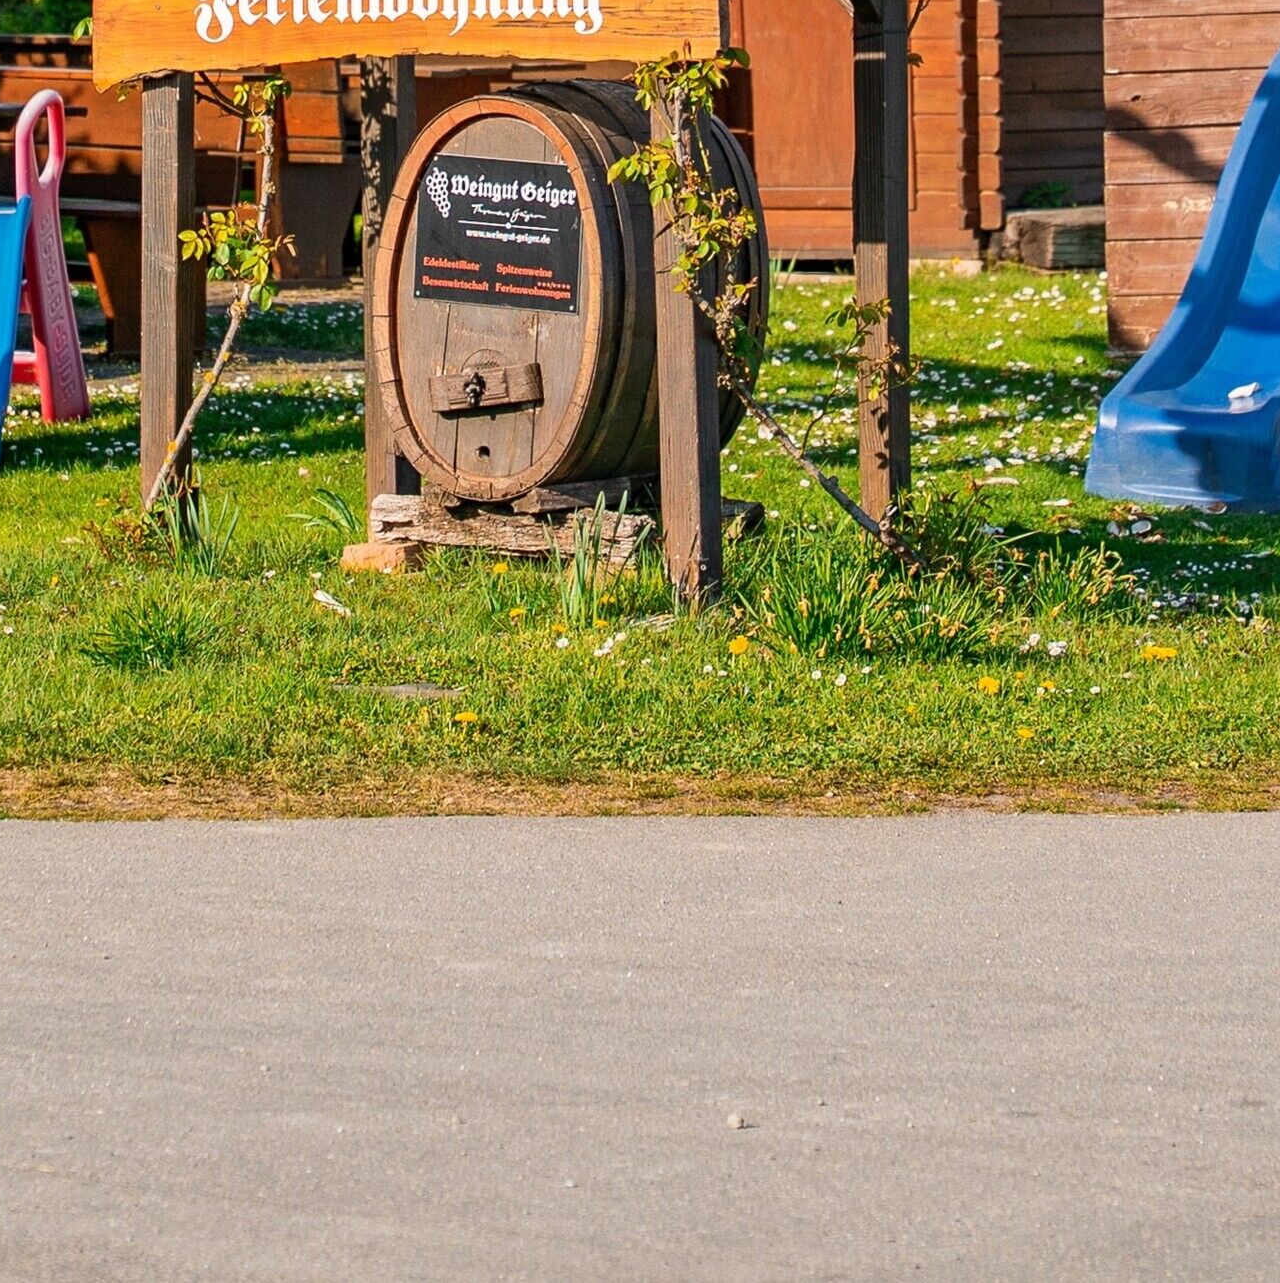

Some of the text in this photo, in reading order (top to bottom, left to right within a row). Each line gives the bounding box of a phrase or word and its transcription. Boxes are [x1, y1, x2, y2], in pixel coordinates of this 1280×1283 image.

[450, 174, 577, 208] Weingut Geiger
[465, 229, 551, 245] www.weingut-geiger.de
[422, 256, 481, 271] Edeldestillate
[496, 263, 554, 279] Spitzenweine
[422, 275, 489, 292] Besenwirtschaft
[495, 282, 571, 300] Ferienwohnungen
